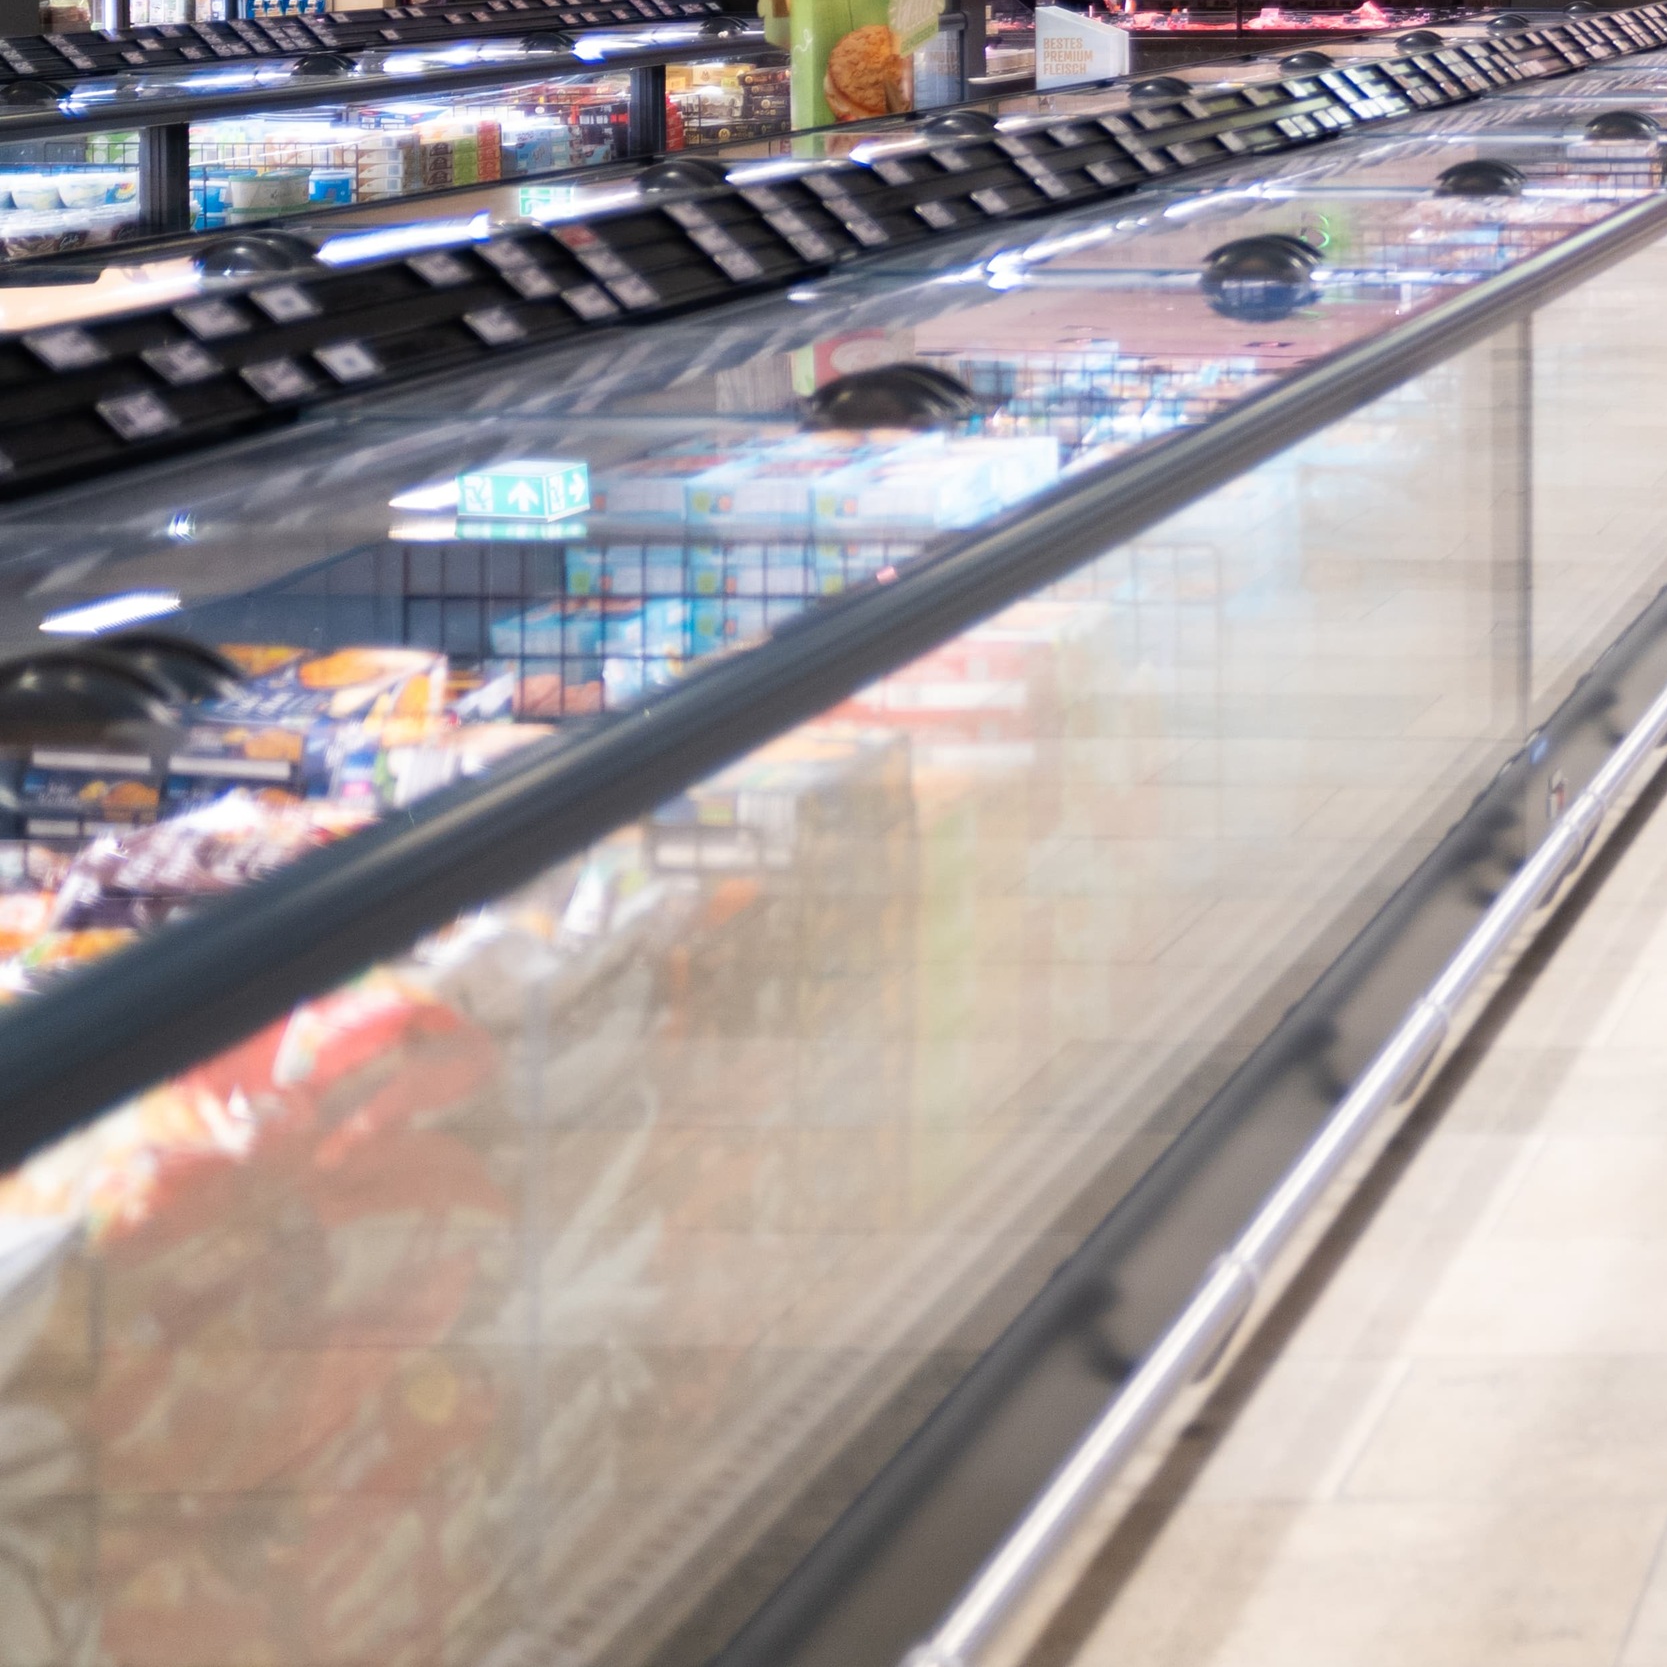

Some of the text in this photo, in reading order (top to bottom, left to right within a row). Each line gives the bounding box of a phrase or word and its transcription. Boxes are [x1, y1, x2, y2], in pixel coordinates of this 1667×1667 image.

[1043, 37, 1083, 49] BESTES
[1043, 49, 1094, 62] PREMIUM
[1043, 63, 1088, 76] FLEISCH
